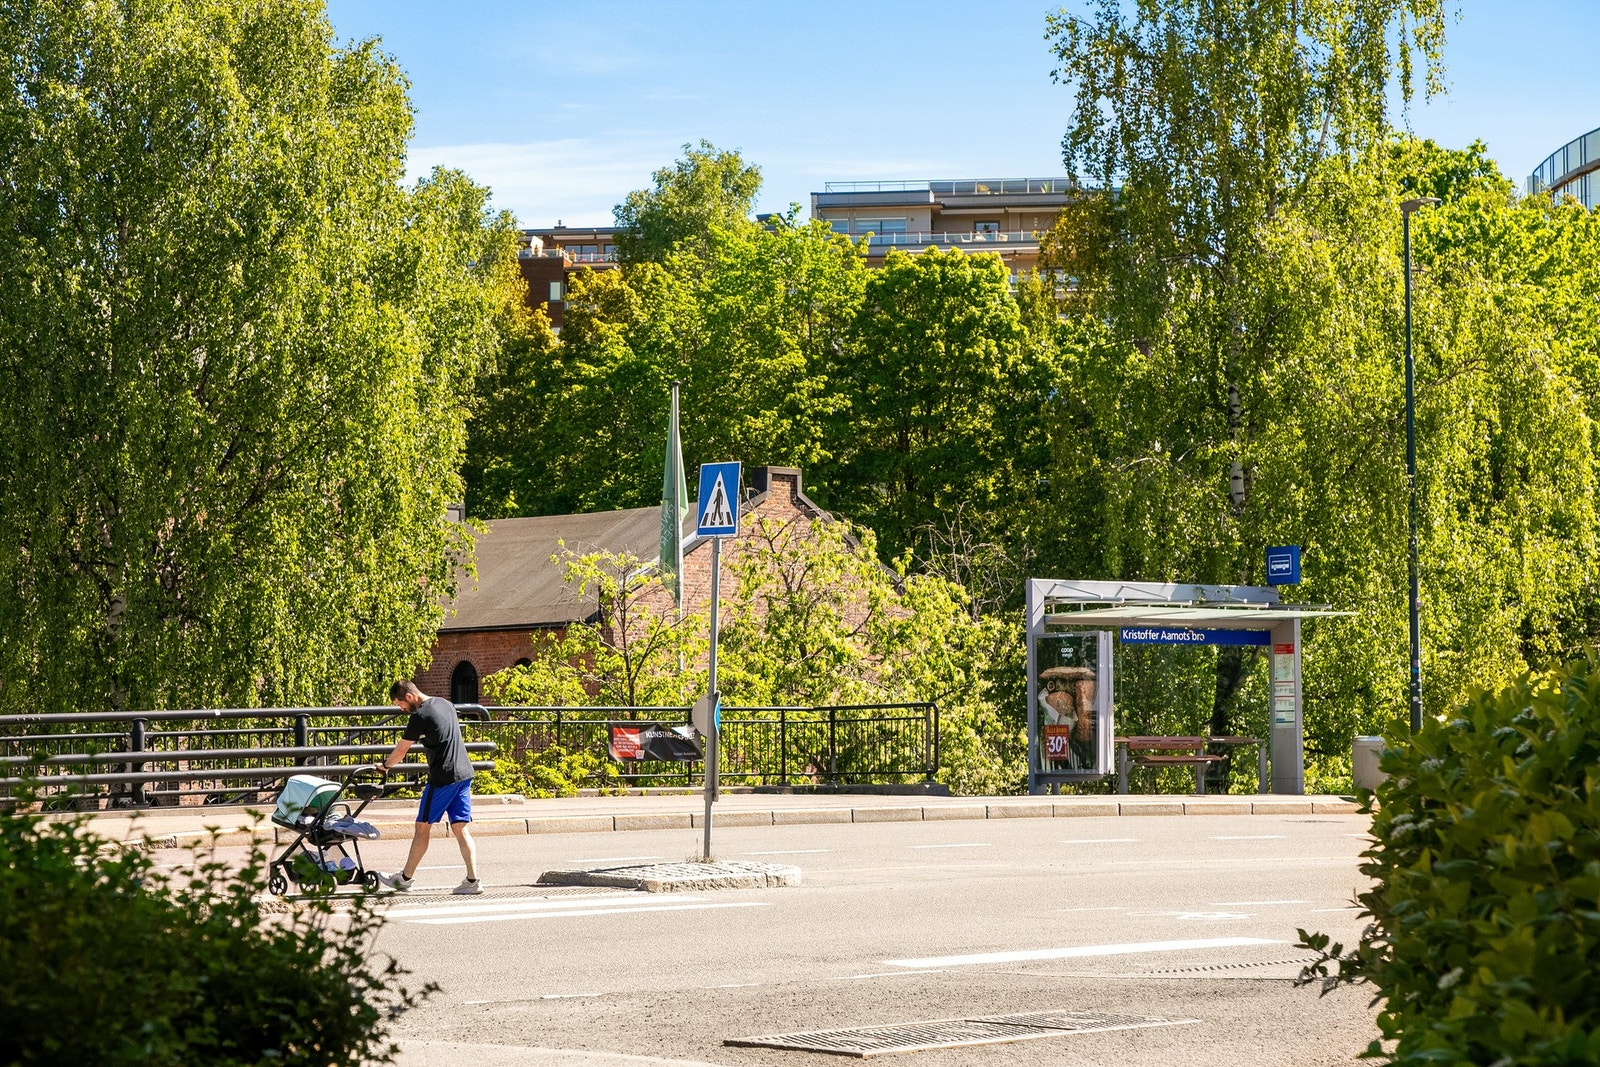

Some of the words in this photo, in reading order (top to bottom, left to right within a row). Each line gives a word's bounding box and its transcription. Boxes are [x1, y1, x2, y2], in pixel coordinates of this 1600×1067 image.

[1122, 629, 1160, 640] Kristoffer
[1160, 630, 1191, 641] Aamots
[1191, 630, 1205, 641] bro
